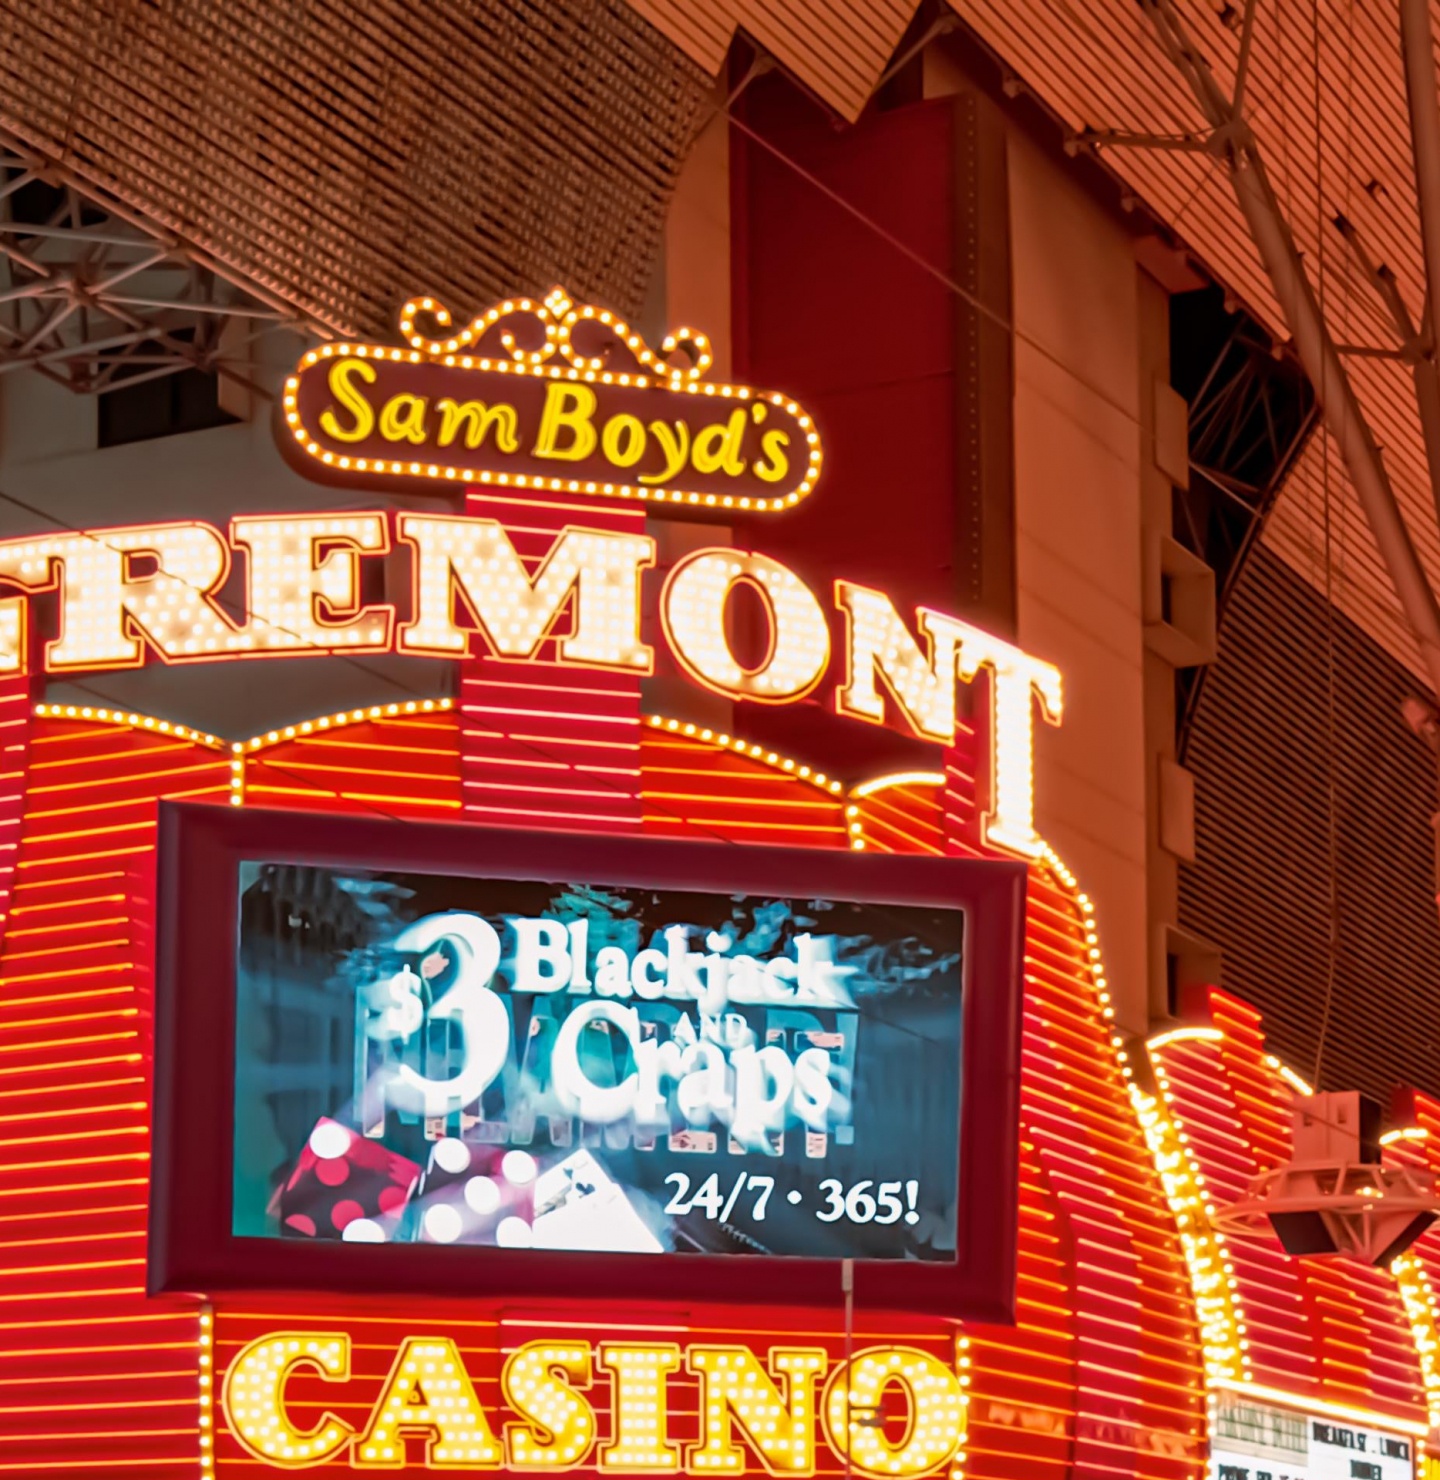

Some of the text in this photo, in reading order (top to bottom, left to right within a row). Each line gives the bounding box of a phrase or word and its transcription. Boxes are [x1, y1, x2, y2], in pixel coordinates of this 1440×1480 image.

[318, 357, 793, 485] Sam Boyd's
[507, 917, 852, 1014] Blackjack
[550, 1000, 833, 1158] Craps
[674, 1011, 752, 1048] AND
[663, 1171, 776, 1223] 24/7
[815, 1178, 921, 1226] 365!
[222, 1330, 968, 1480] CASINO
